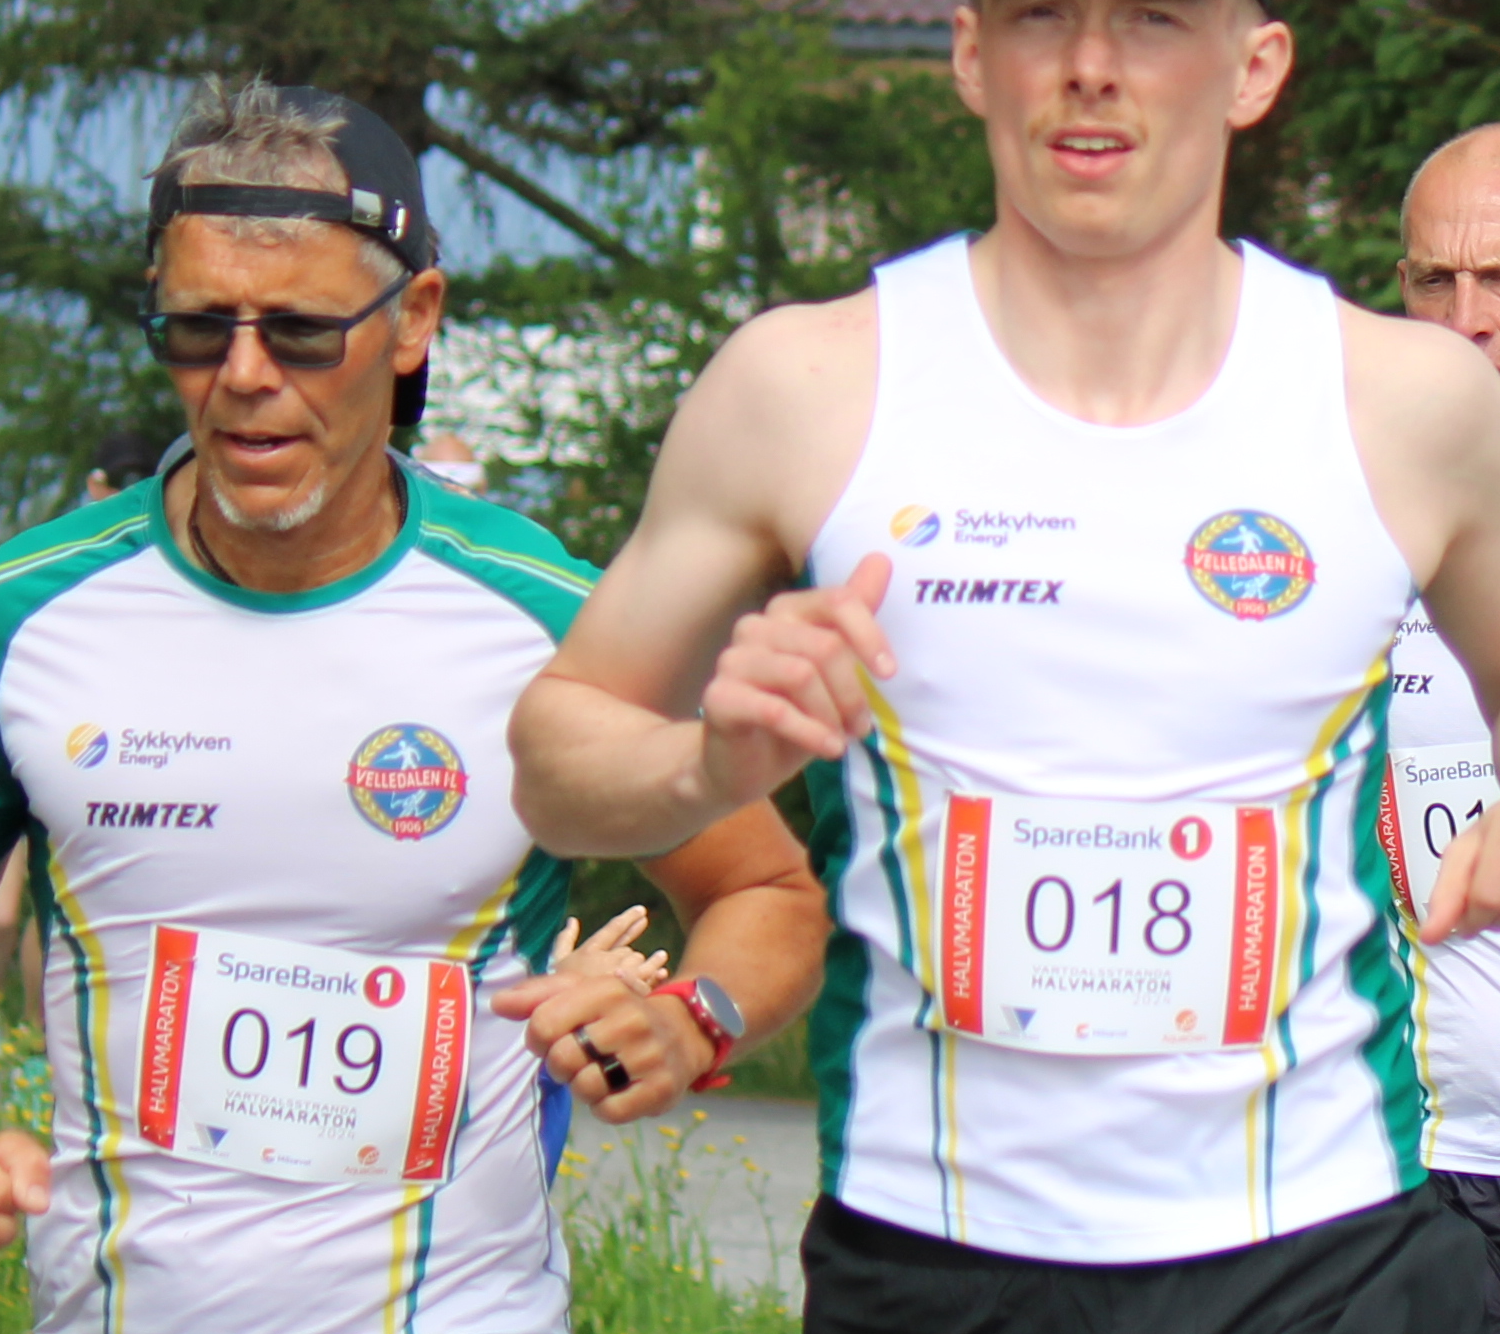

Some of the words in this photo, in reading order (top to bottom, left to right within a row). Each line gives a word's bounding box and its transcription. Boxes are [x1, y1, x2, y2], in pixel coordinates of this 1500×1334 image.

[955, 509, 1075, 535] Sykkylven
[954, 531, 1008, 546] Energi
[1193, 551, 1286, 573] VELLEDALEN
[915, 580, 1065, 603] TRIMTEX
[120, 729, 231, 754] Sykkylven
[119, 751, 168, 768] Energi
[356, 768, 440, 789] VELLEDALEN
[443, 771, 458, 788] IL
[1405, 761, 1495, 786] SpareBan
[86, 803, 220, 828] TRIMTEX
[395, 820, 421, 833] 1906
[1013, 819, 1162, 852] SpareBank
[954, 834, 976, 998] HALVMARATON
[1025, 875, 1193, 955] 018
[1239, 846, 1266, 1011] HALVMARATON
[216, 953, 358, 997] SpareBank
[1031, 976, 1171, 994] HALVMARATON
[152, 960, 182, 1114] HALVMARATON
[221, 1008, 383, 1095] 019
[421, 998, 456, 1149] HALVMARATON
[224, 1099, 357, 1129] HALVMARATON
